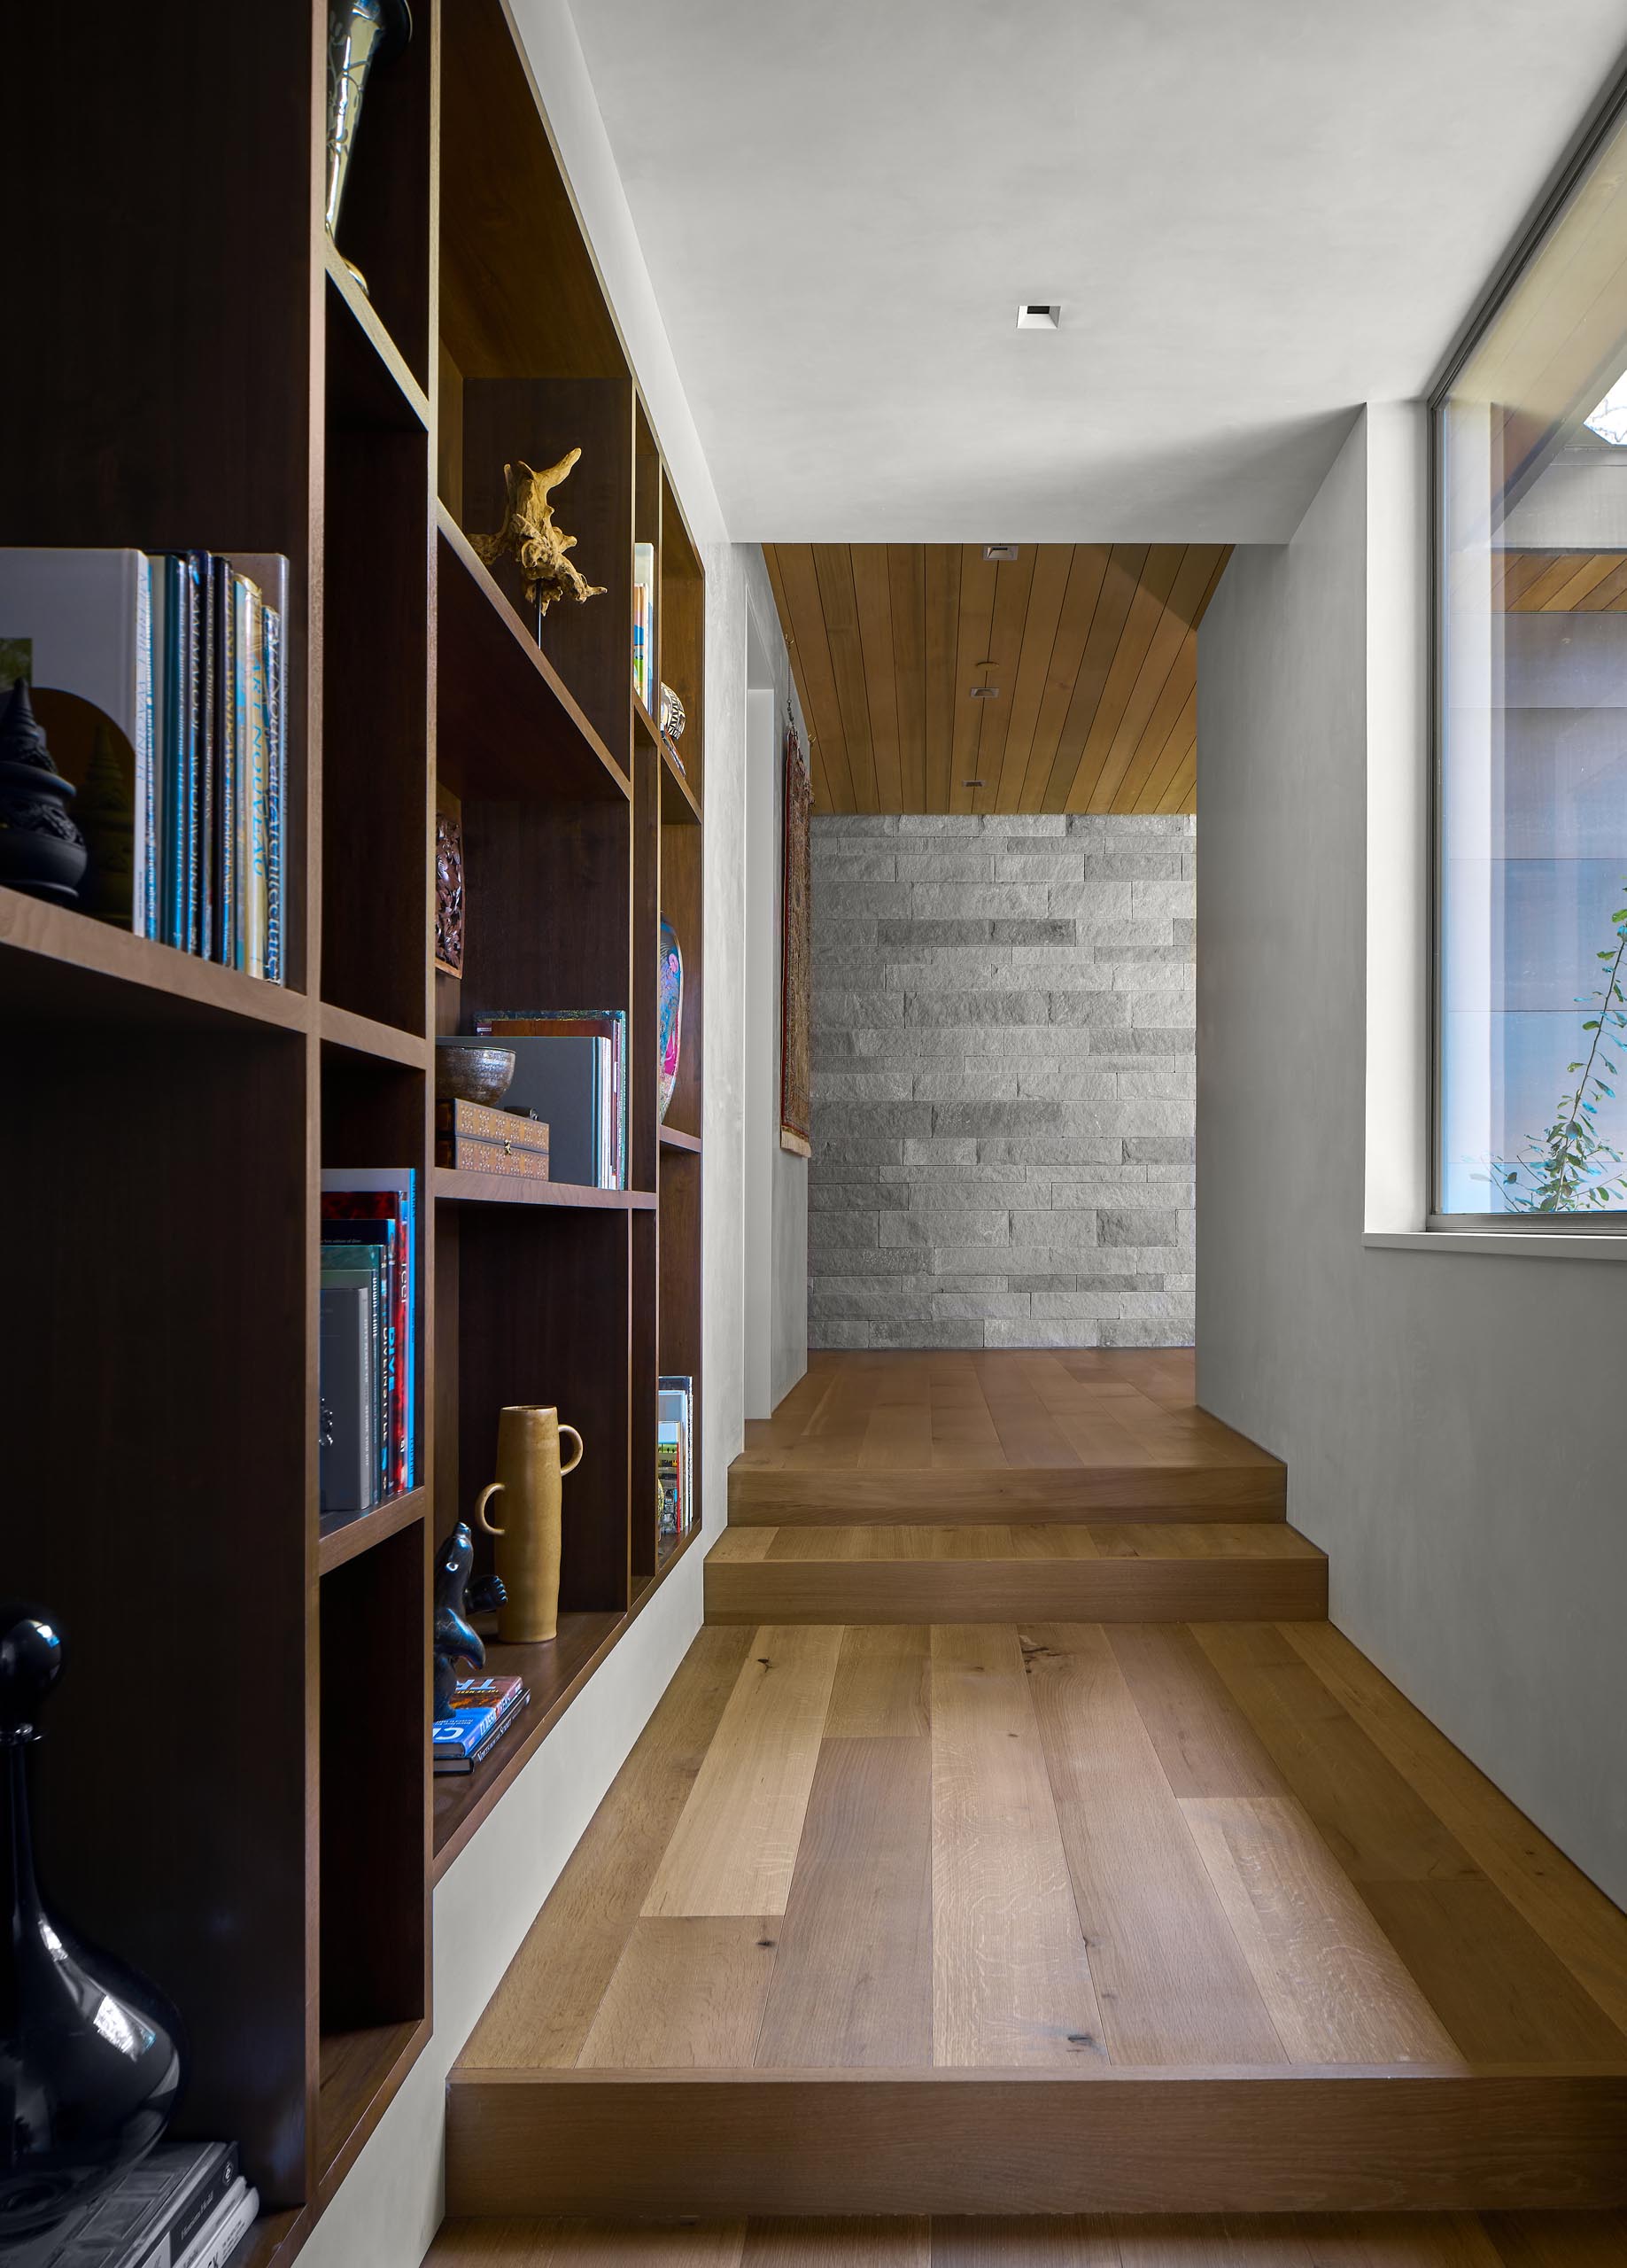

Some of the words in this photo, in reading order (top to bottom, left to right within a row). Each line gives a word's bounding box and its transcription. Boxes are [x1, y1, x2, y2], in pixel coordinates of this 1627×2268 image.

[253, 654, 262, 709] ART
[190, 755, 199, 913] WOODWORKER
[252, 725, 263, 877] NOUVEAU
